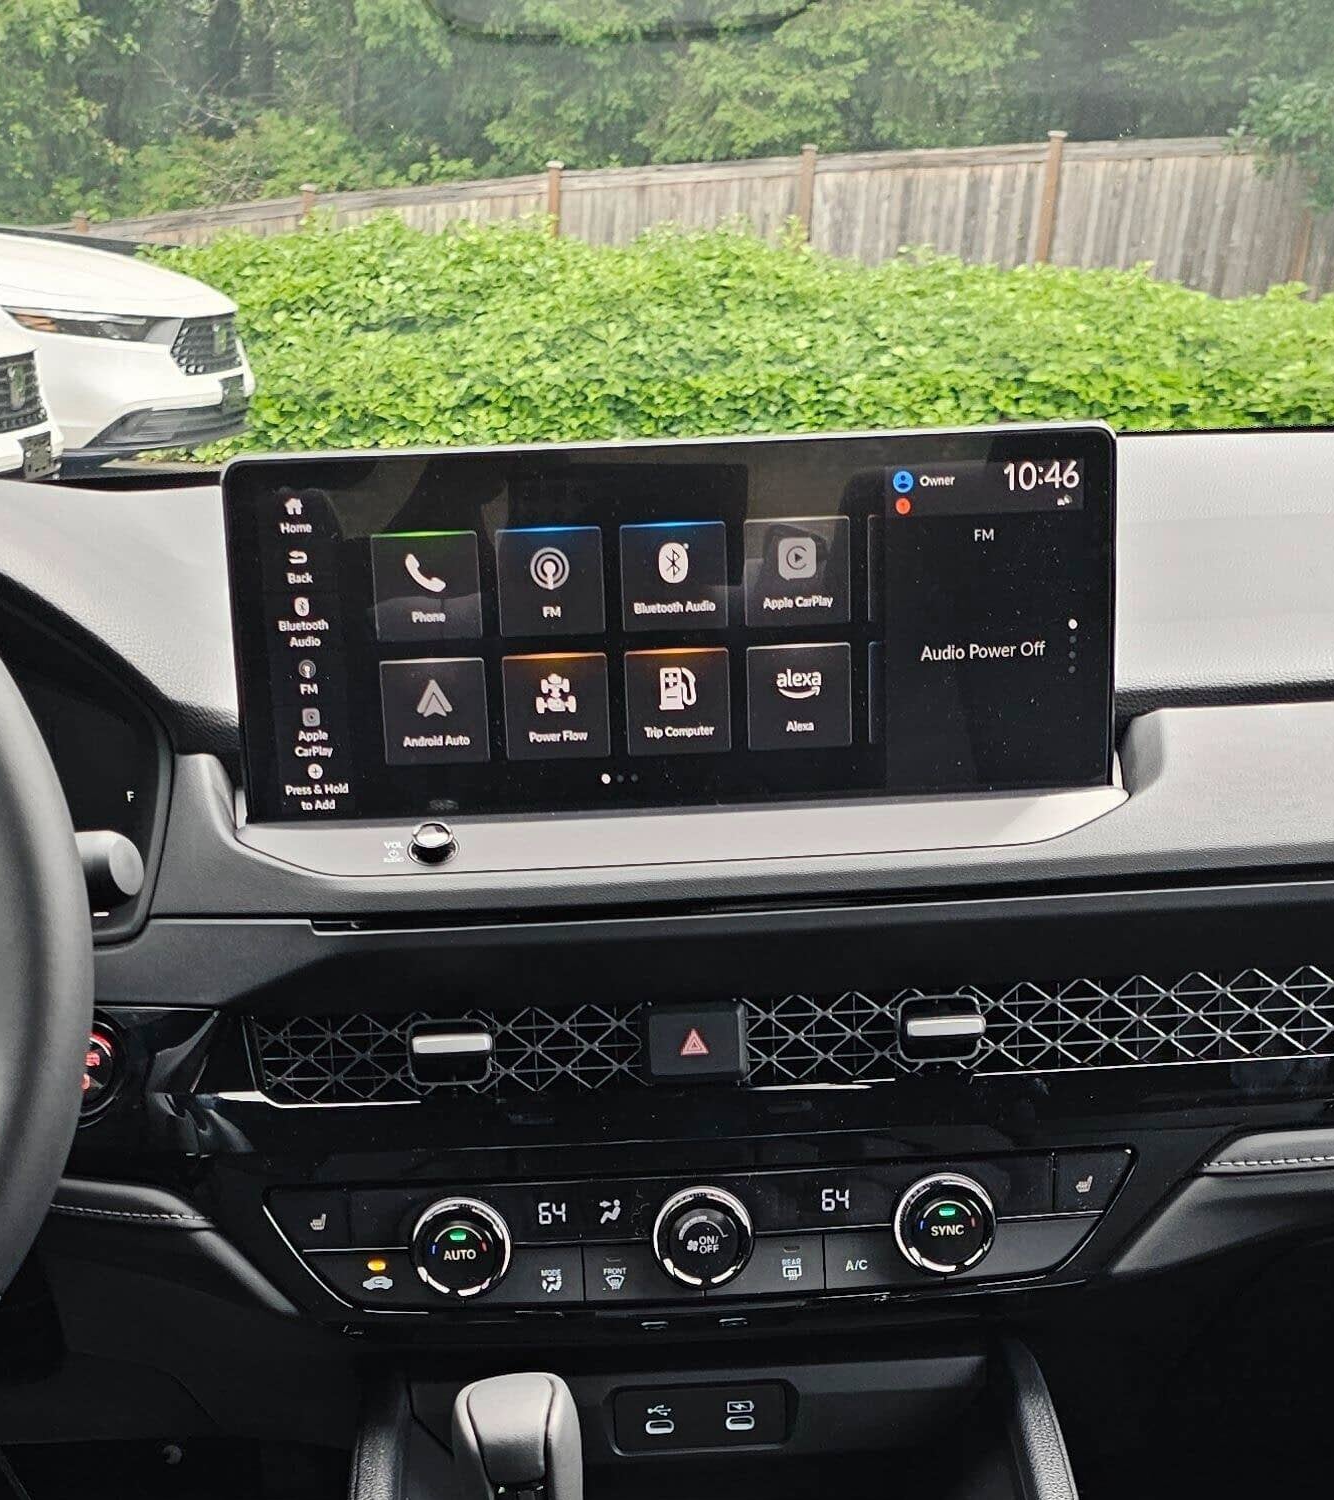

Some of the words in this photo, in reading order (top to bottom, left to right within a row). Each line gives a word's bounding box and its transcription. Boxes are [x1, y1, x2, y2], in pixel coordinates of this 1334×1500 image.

[919, 475, 955, 487] Owner
[1003, 460, 1080, 491] 10:46
[280, 522, 312, 534] Home
[974, 529, 995, 542] FM
[287, 572, 313, 584] Back
[633, 602, 683, 615] Bluetooth
[685, 600, 716, 613] Audio
[763, 597, 794, 610] Apple
[795, 595, 833, 608] CarPlay
[411, 611, 446, 623] Phone
[542, 606, 561, 618] FM
[278, 619, 329, 632] Bluetooth
[289, 635, 321, 648] Audio
[920, 644, 965, 661] Audio
[969, 643, 1016, 659] Power
[1020, 641, 1045, 657] Off
[776, 669, 822, 688] alexa
[299, 684, 318, 695] FM
[644, 727, 663, 739] Trip
[665, 725, 714, 739] Computer
[786, 720, 814, 732] Alexa
[298, 730, 328, 743] Apple
[403, 736, 443, 748] Android
[445, 735, 470, 747] Auto
[529, 731, 561, 743] Power
[563, 730, 588, 742] Flow
[294, 746, 333, 758] CarPlay
[127, 790, 135, 802] F
[285, 784, 312, 797] Press
[313, 784, 323, 796] &
[324, 783, 349, 795] Hold
[301, 800, 313, 811] to
[314, 799, 336, 811] Add
[821, 1188, 850, 1212] 64
[538, 1202, 566, 1225] 64
[930, 1224, 964, 1237] SYNC
[698, 1235, 719, 1246] ON/
[443, 1249, 477, 1261] AUTO
[699, 1244, 720, 1255] OFF
[782, 1258, 802, 1267] REAR
[845, 1259, 868, 1272] A/C
[541, 1269, 562, 1277] MODE
[603, 1267, 627, 1275] FRONT
